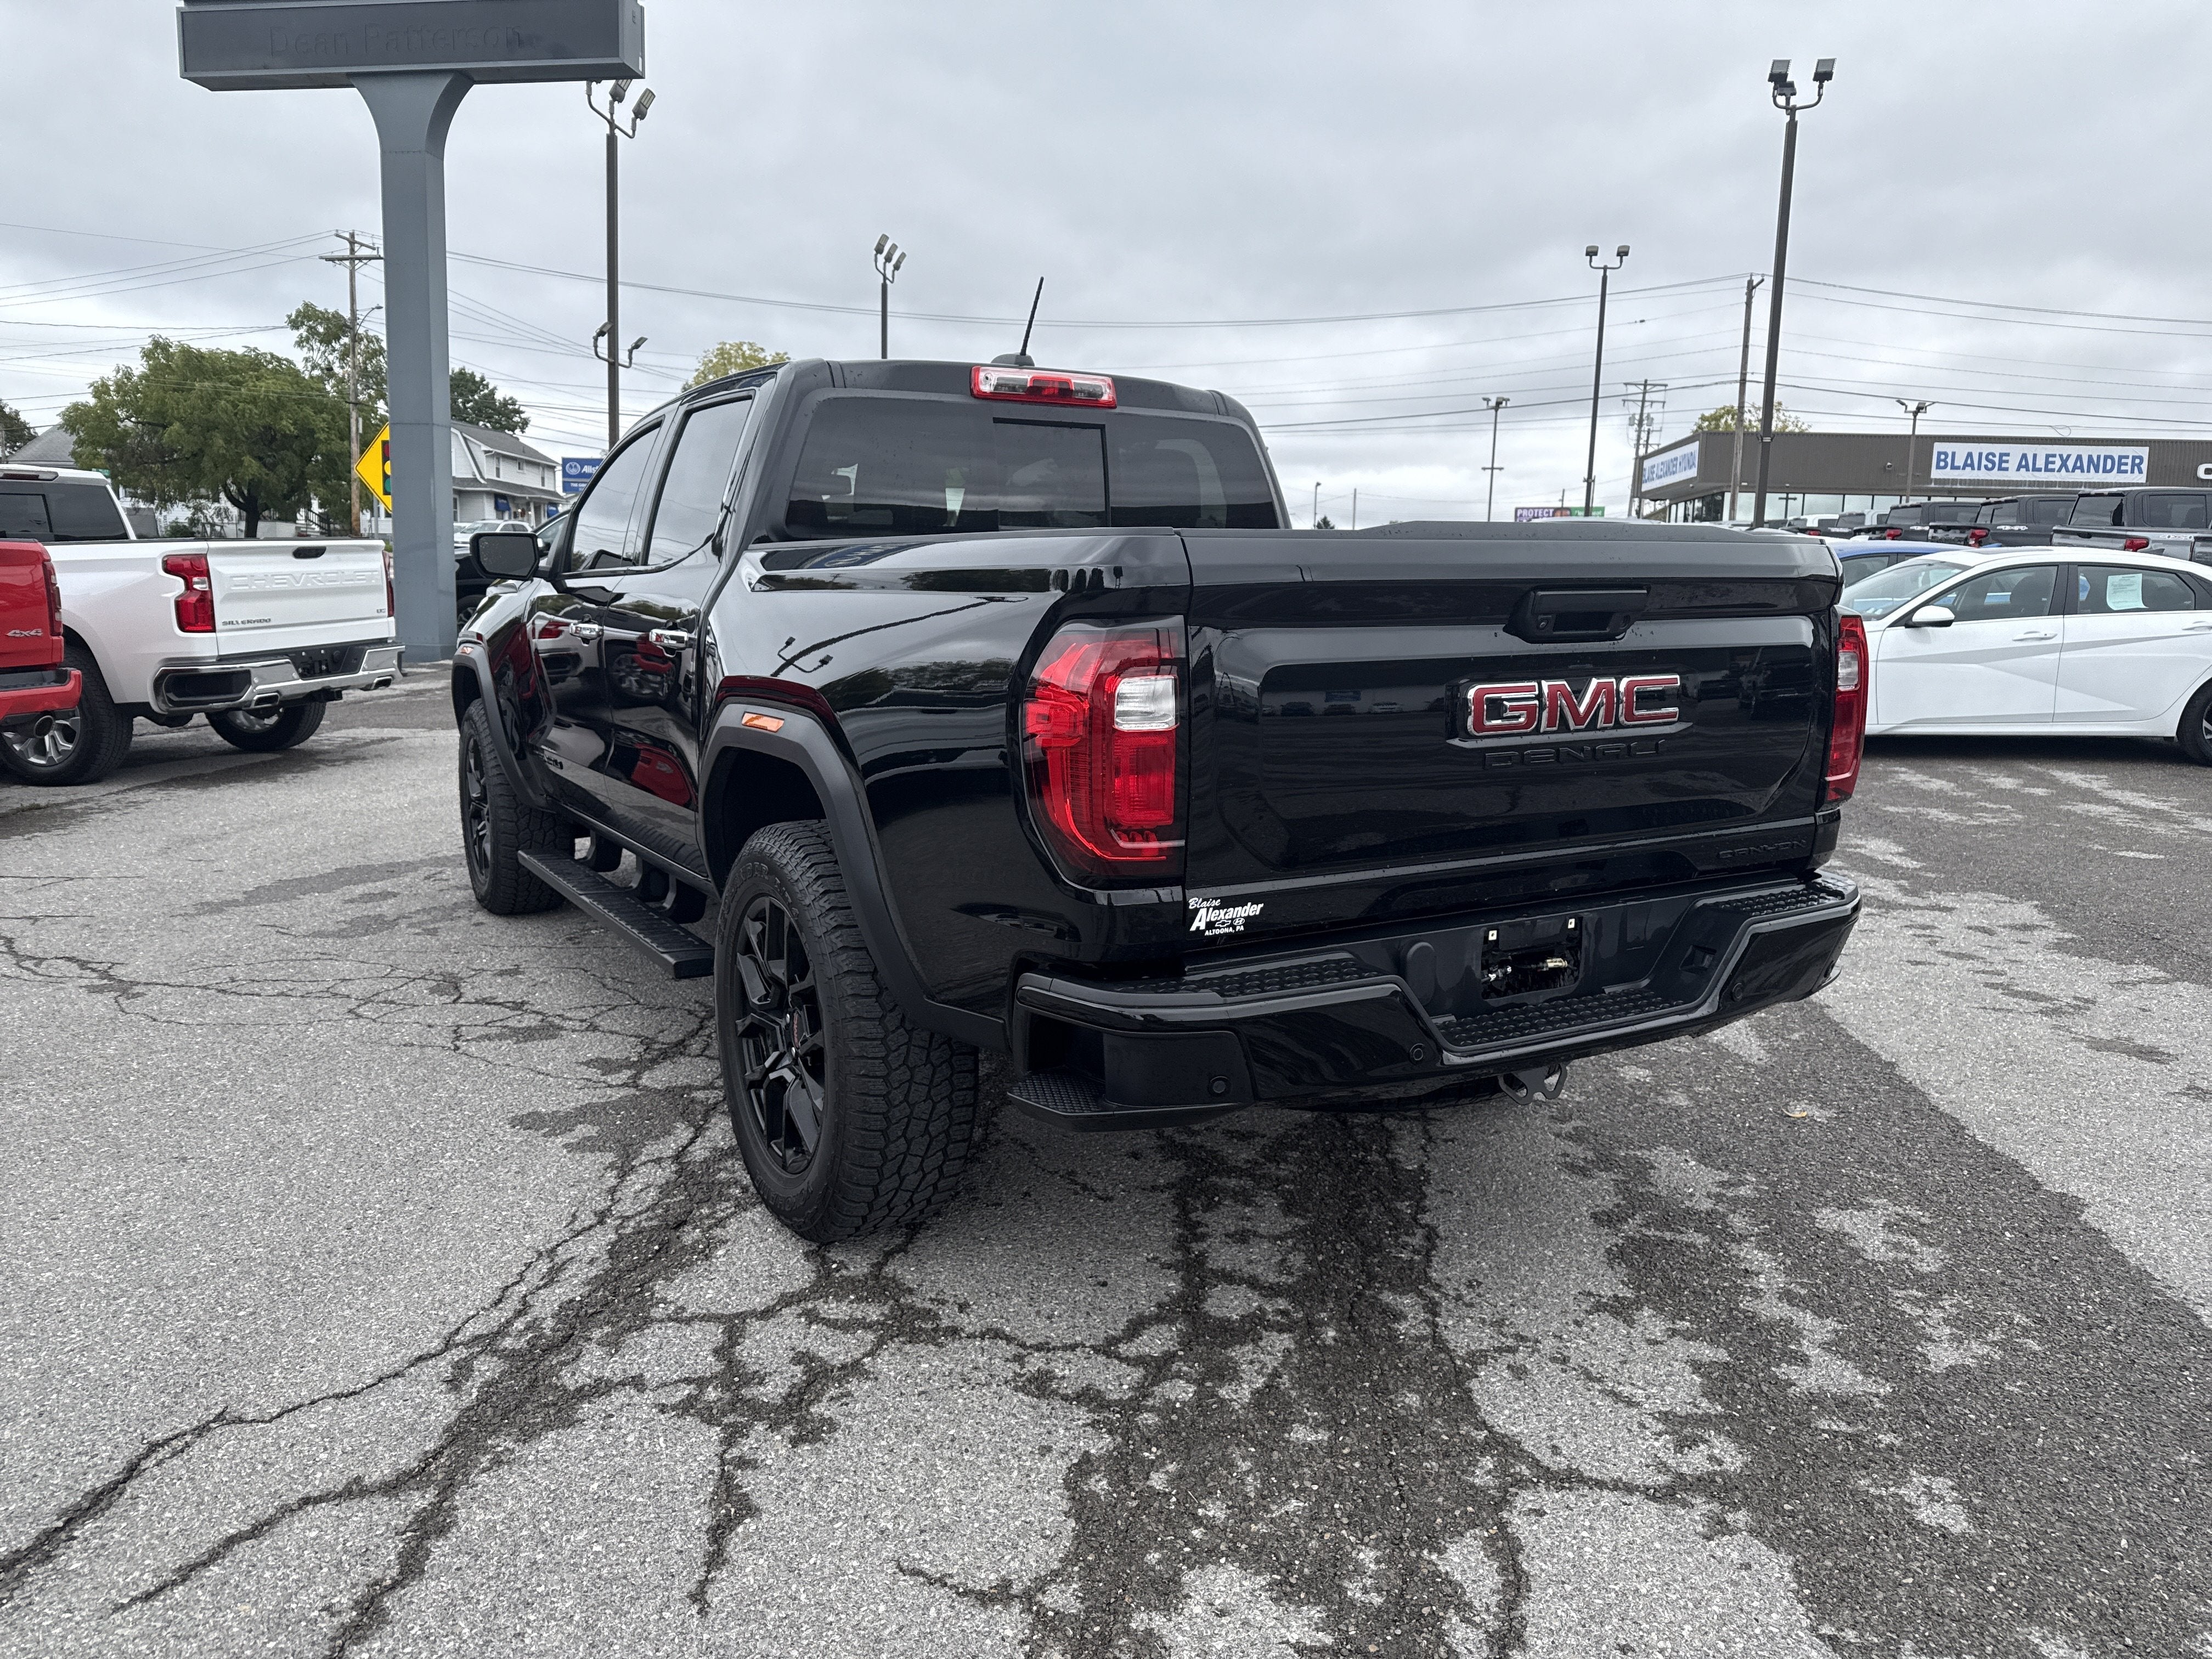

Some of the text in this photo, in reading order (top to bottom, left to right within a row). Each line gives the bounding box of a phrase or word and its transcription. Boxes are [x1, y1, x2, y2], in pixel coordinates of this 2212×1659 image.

[270, 23, 521, 55] Dean Patterson
[1935, 451, 2145, 474] BLAISE ALEXANDER
[1517, 509, 1554, 517] PROTECT
[230, 571, 380, 590] CHEVROLET
[222, 618, 272, 626] SILVERADO
[1467, 674, 1680, 736] GMC
[1485, 739, 1666, 768] DENALI
[1188, 897, 1221, 909] Blaise
[1189, 902, 1264, 932] Alexander
[1204, 927, 1234, 936] ALTOONA,
